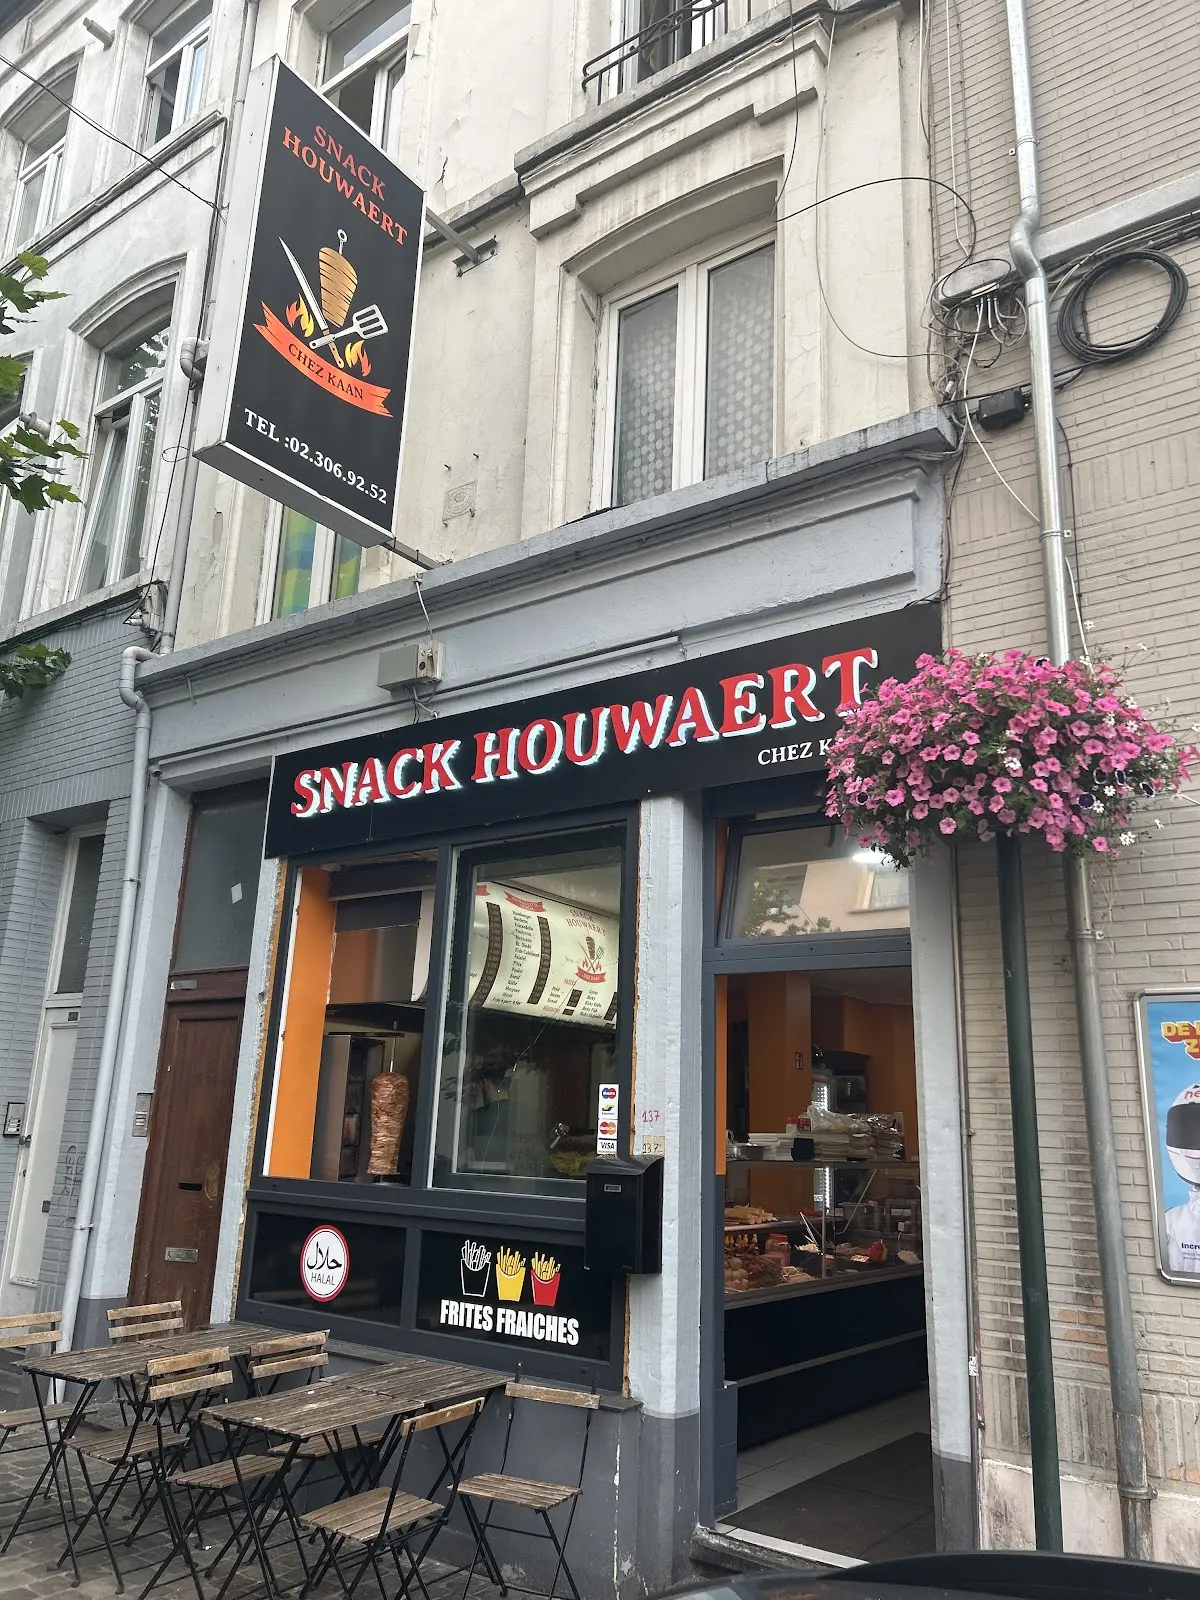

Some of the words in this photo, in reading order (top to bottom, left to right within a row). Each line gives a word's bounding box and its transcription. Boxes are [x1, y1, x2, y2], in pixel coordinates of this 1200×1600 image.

[314, 125, 386, 201] SNACK
[282, 126, 408, 246] HOUWAERT
[287, 343, 325, 380] CHEZ
[327, 373, 364, 401] KAAN
[244, 408, 280, 444] TEL
[471, 646, 879, 784] HOUWAERT
[757, 741, 813, 766] CHEZ
[291, 739, 462, 818] SNACK
[1161, 1021, 1191, 1042] DE
[642, 1109, 661, 1123] 137
[306, 1240, 343, 1270] حلال
[310, 1271, 336, 1286] HALAL
[440, 1298, 494, 1332] FRITES
[496, 1307, 580, 1346] FRAICHES
